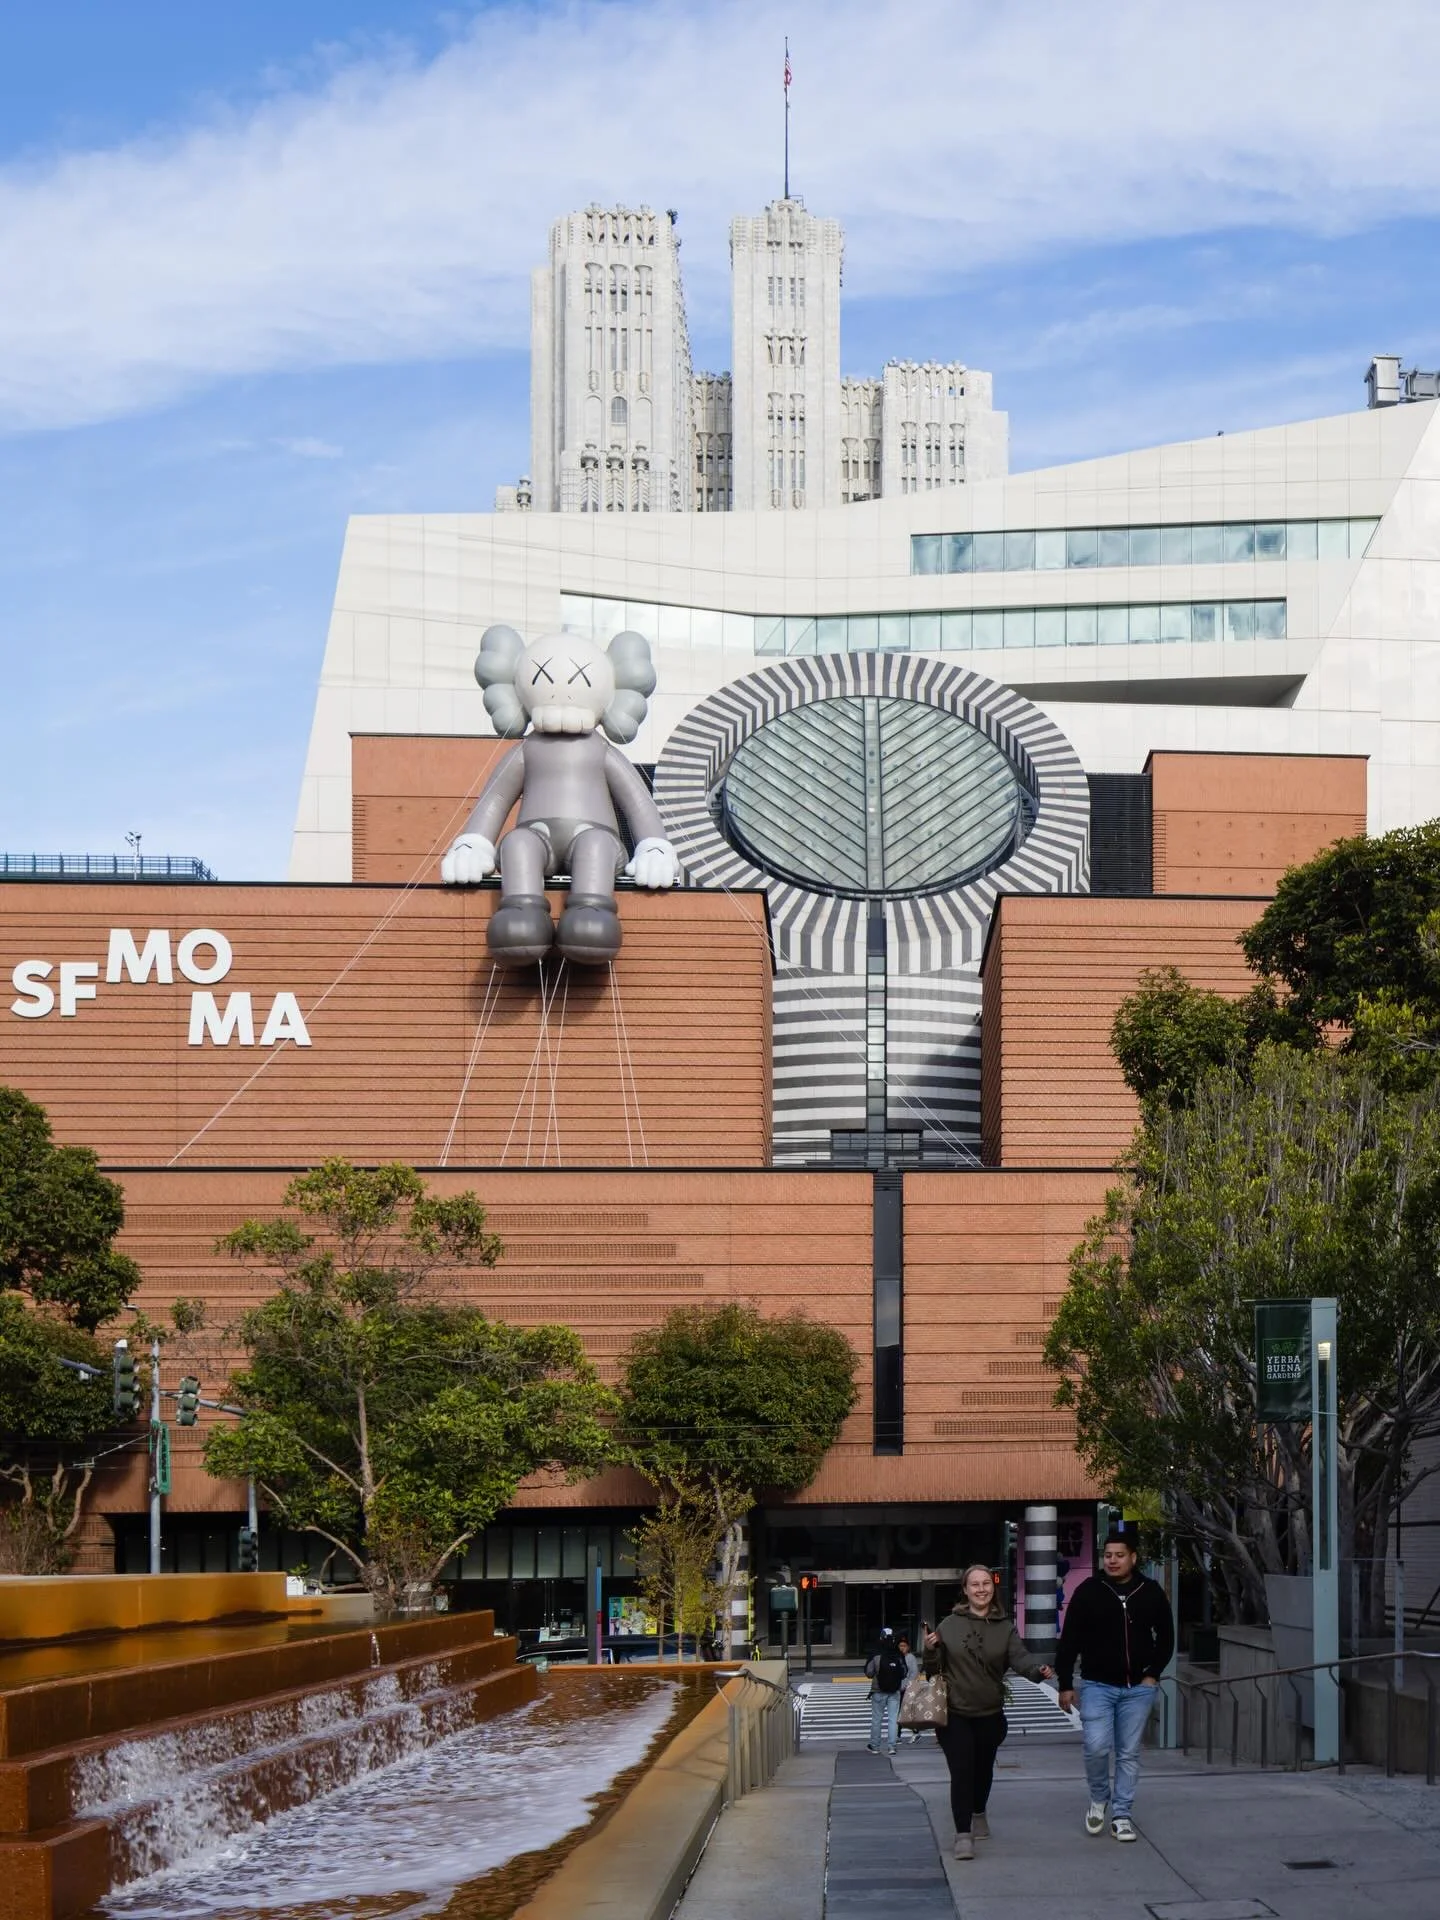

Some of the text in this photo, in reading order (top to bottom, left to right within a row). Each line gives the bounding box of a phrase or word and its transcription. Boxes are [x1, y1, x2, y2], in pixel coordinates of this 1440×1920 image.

[105, 928, 233, 985] MO
[10, 959, 99, 1018] SF
[187, 991, 313, 1046] MA
[1266, 1355, 1301, 1364] YERBA
[1266, 1364, 1301, 1372] BUENA
[1266, 1372, 1301, 1380] GARDENS
